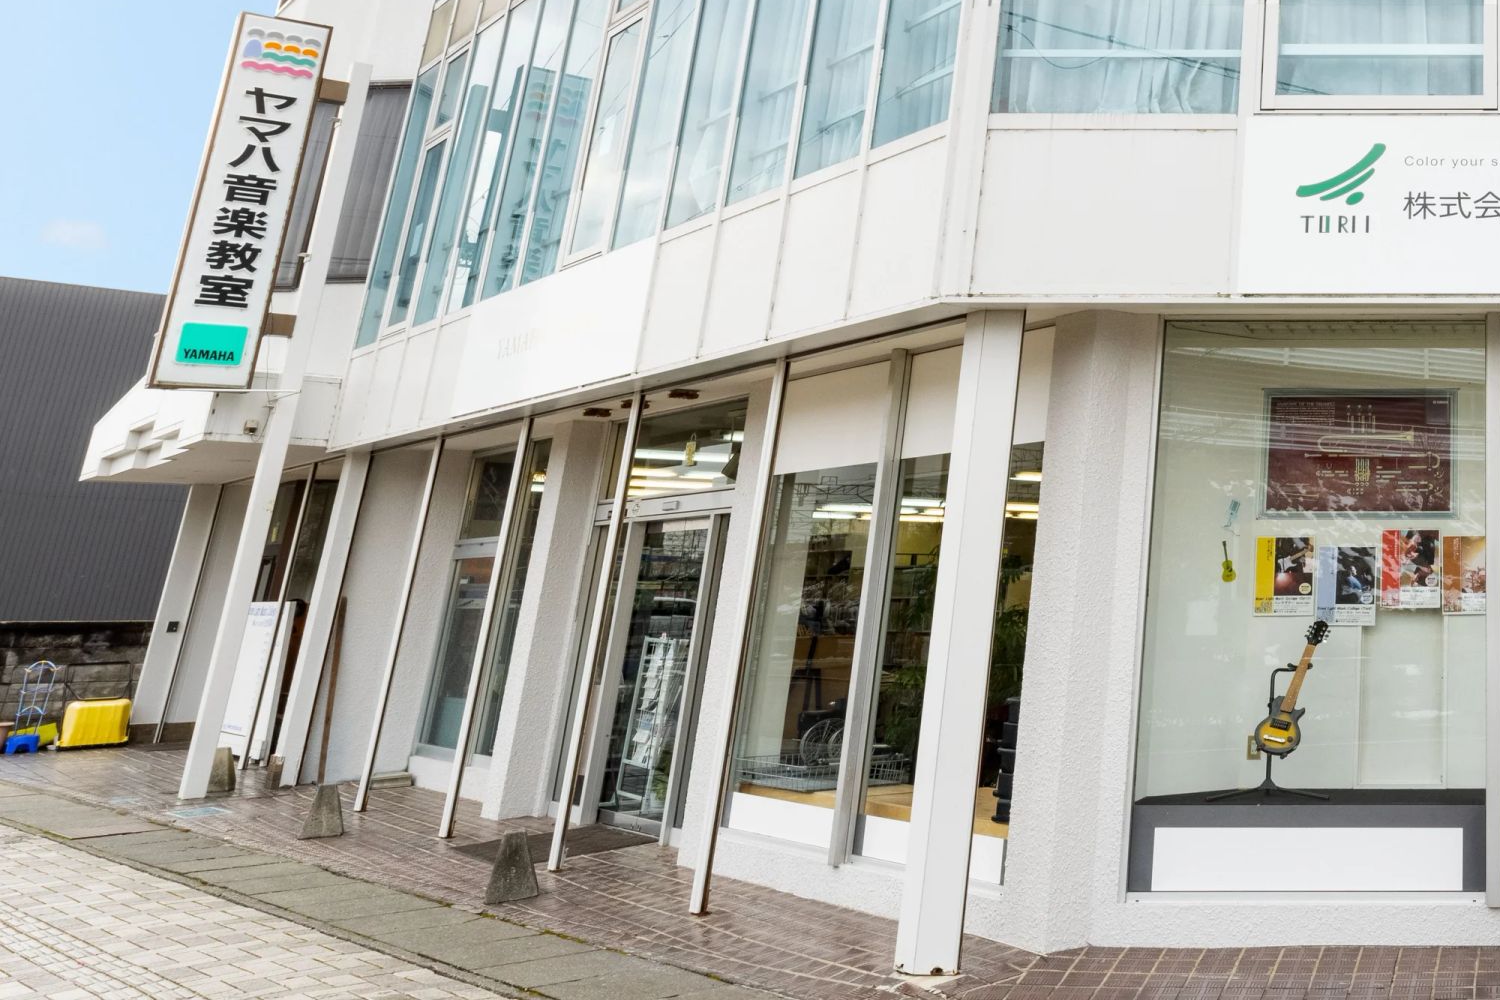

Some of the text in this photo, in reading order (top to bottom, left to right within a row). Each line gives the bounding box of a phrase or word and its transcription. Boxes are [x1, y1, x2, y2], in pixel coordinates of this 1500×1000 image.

[1404, 155, 1447, 168] Color
[1452, 157, 1486, 170] your
[194, 86, 298, 310] ヤマハ音楽教室
[183, 347, 235, 363] YAMAHA
